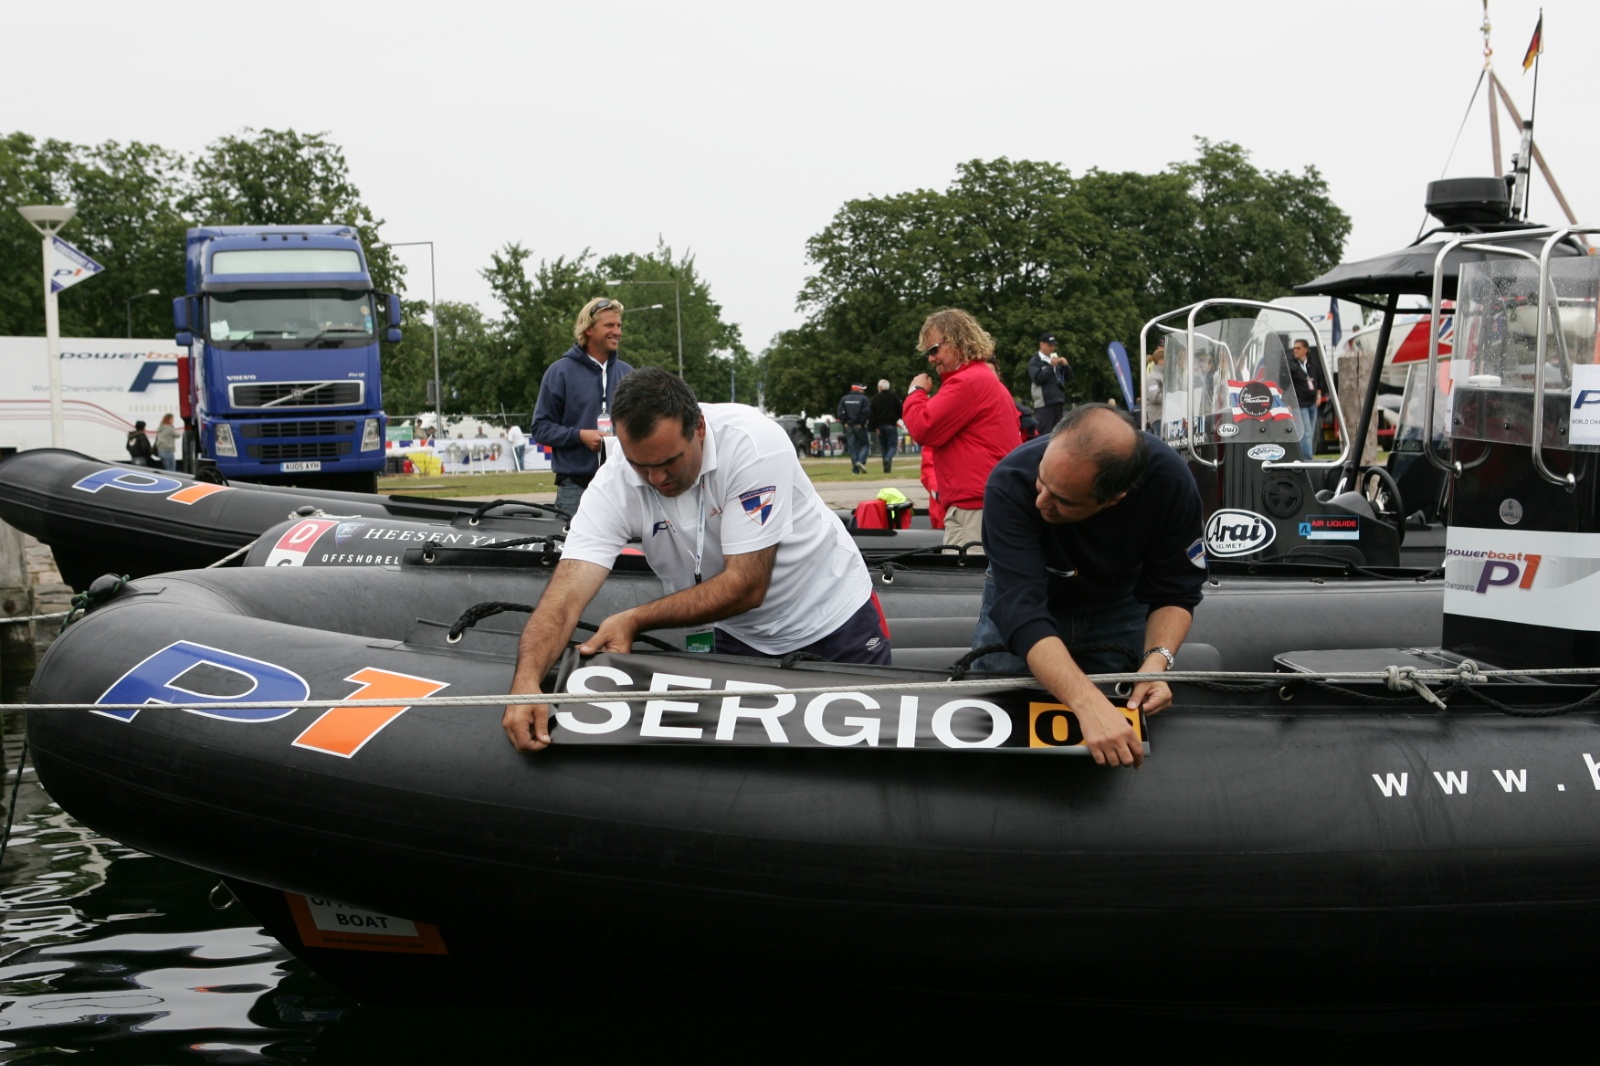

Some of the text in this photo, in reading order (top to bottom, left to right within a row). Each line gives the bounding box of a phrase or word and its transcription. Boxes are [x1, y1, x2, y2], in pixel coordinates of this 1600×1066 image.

[72, 468, 237, 505] P1
[363, 528, 464, 545] HEESEN
[1207, 516, 1263, 543] Arai
[1311, 519, 1324, 527] AIR
[1446, 548, 1524, 561] powerboat
[1476, 554, 1541, 594] P1
[89, 640, 451, 759] P1
[555, 666, 1013, 748] SERGIO
[335, 913, 388, 929] BOAT
